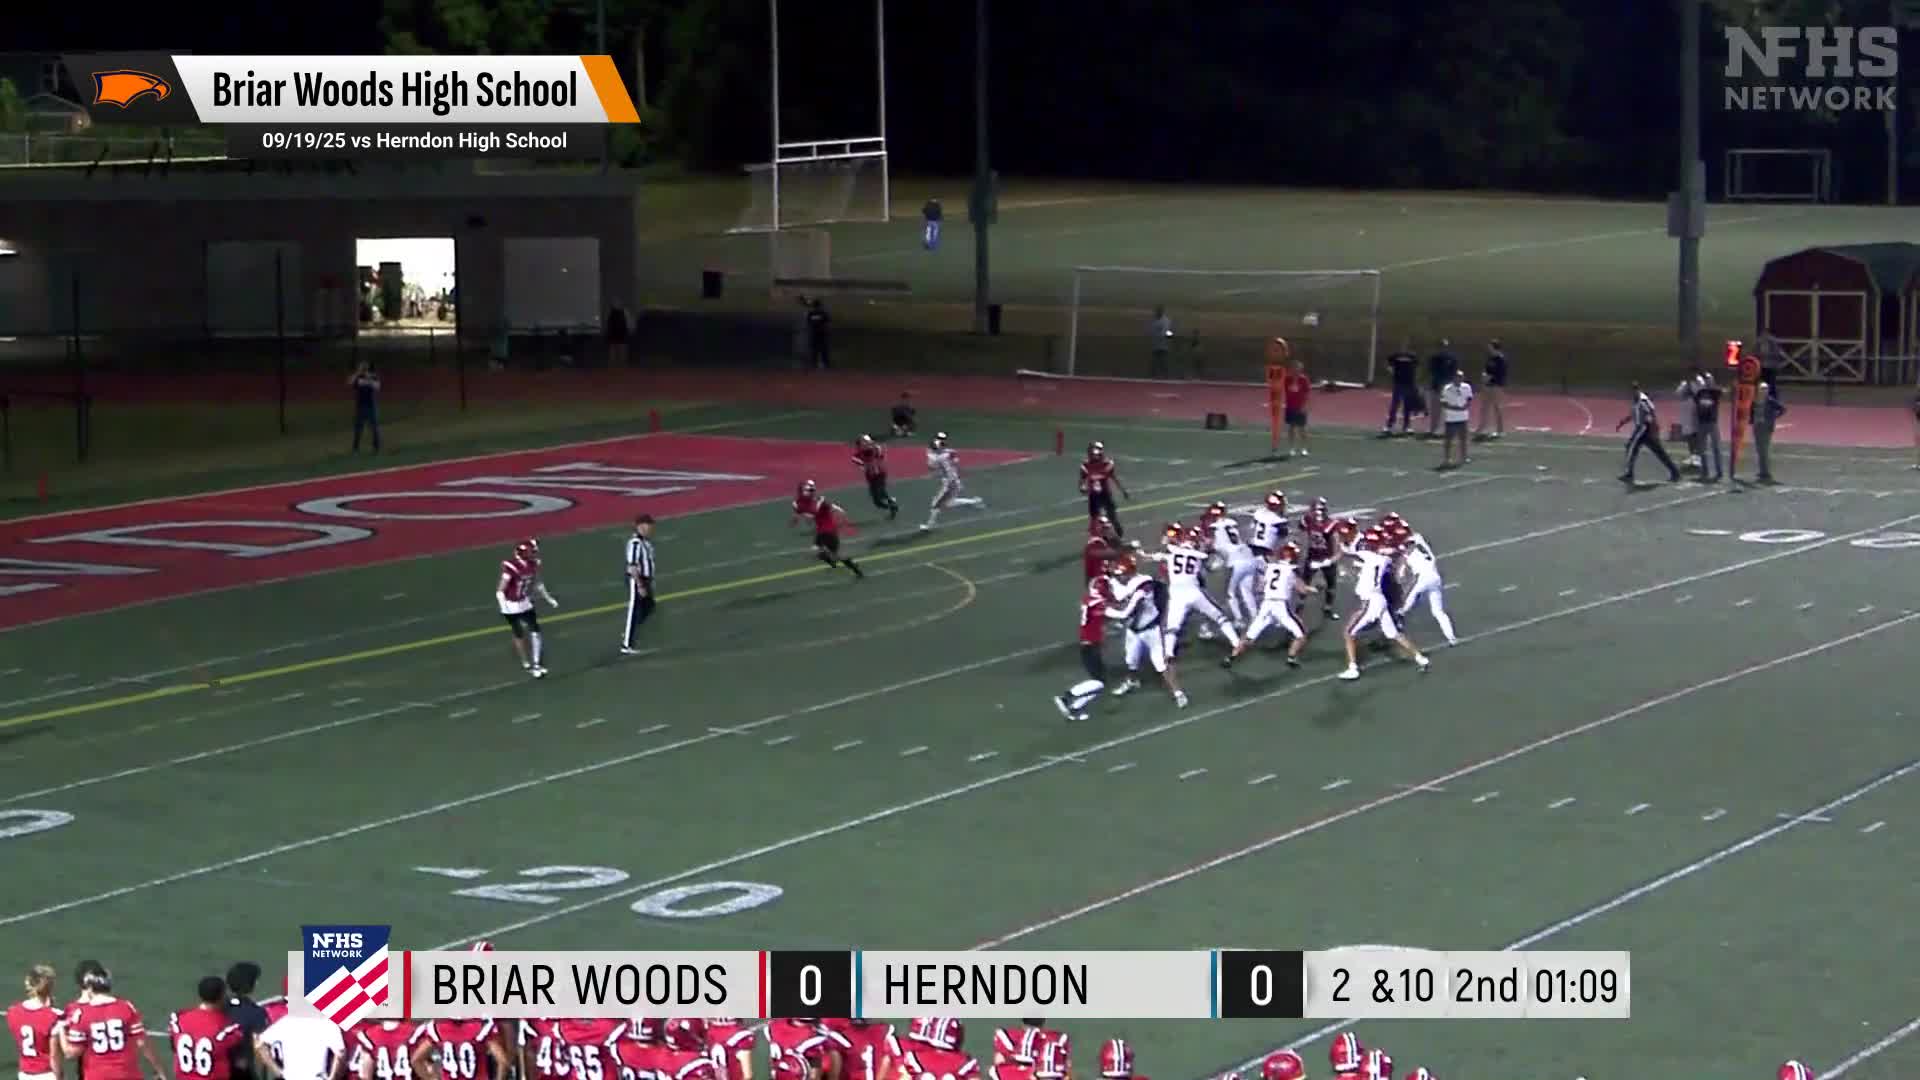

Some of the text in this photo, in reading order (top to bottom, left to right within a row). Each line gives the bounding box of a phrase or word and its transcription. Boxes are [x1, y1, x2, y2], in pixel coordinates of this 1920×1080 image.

[1172, 553, 1198, 575] 56
[1269, 568, 1281, 590] 2
[20, 1024, 38, 1057] 2
[90, 1018, 126, 1054] 55
[176, 1033, 214, 1077] 66
[376, 1045, 413, 1080] 44
[442, 1040, 477, 1079] 40
